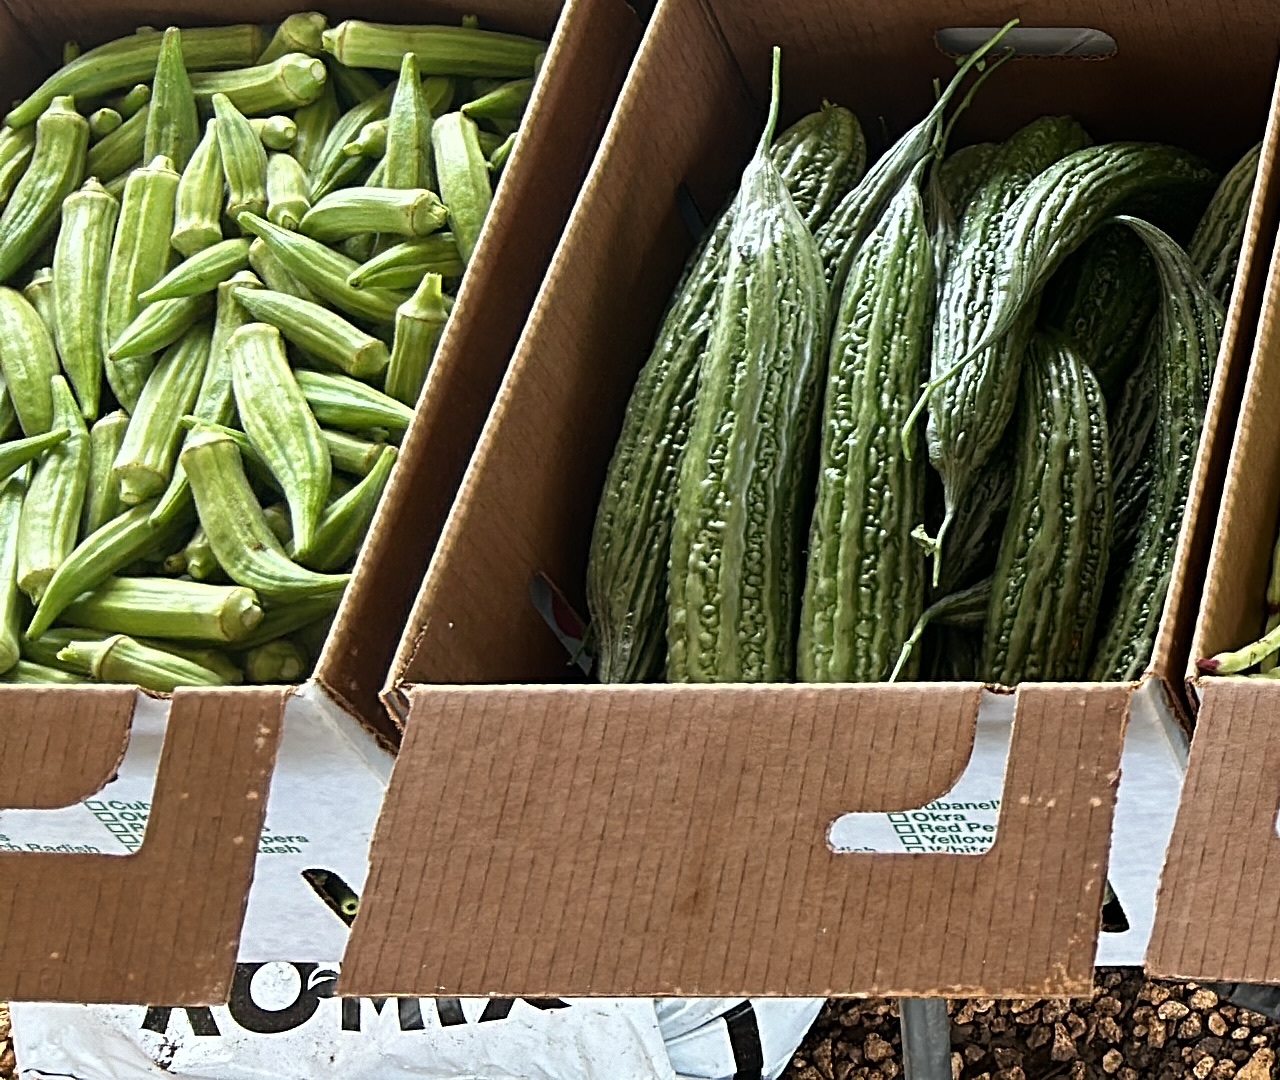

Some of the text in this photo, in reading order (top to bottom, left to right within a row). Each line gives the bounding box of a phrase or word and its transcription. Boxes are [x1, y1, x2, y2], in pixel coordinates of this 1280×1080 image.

[925, 800, 1000, 811] ubanel
[912, 812, 967, 822] Okra
[917, 823, 997, 833] Red Pe
[922, 834, 993, 845] Yellow
